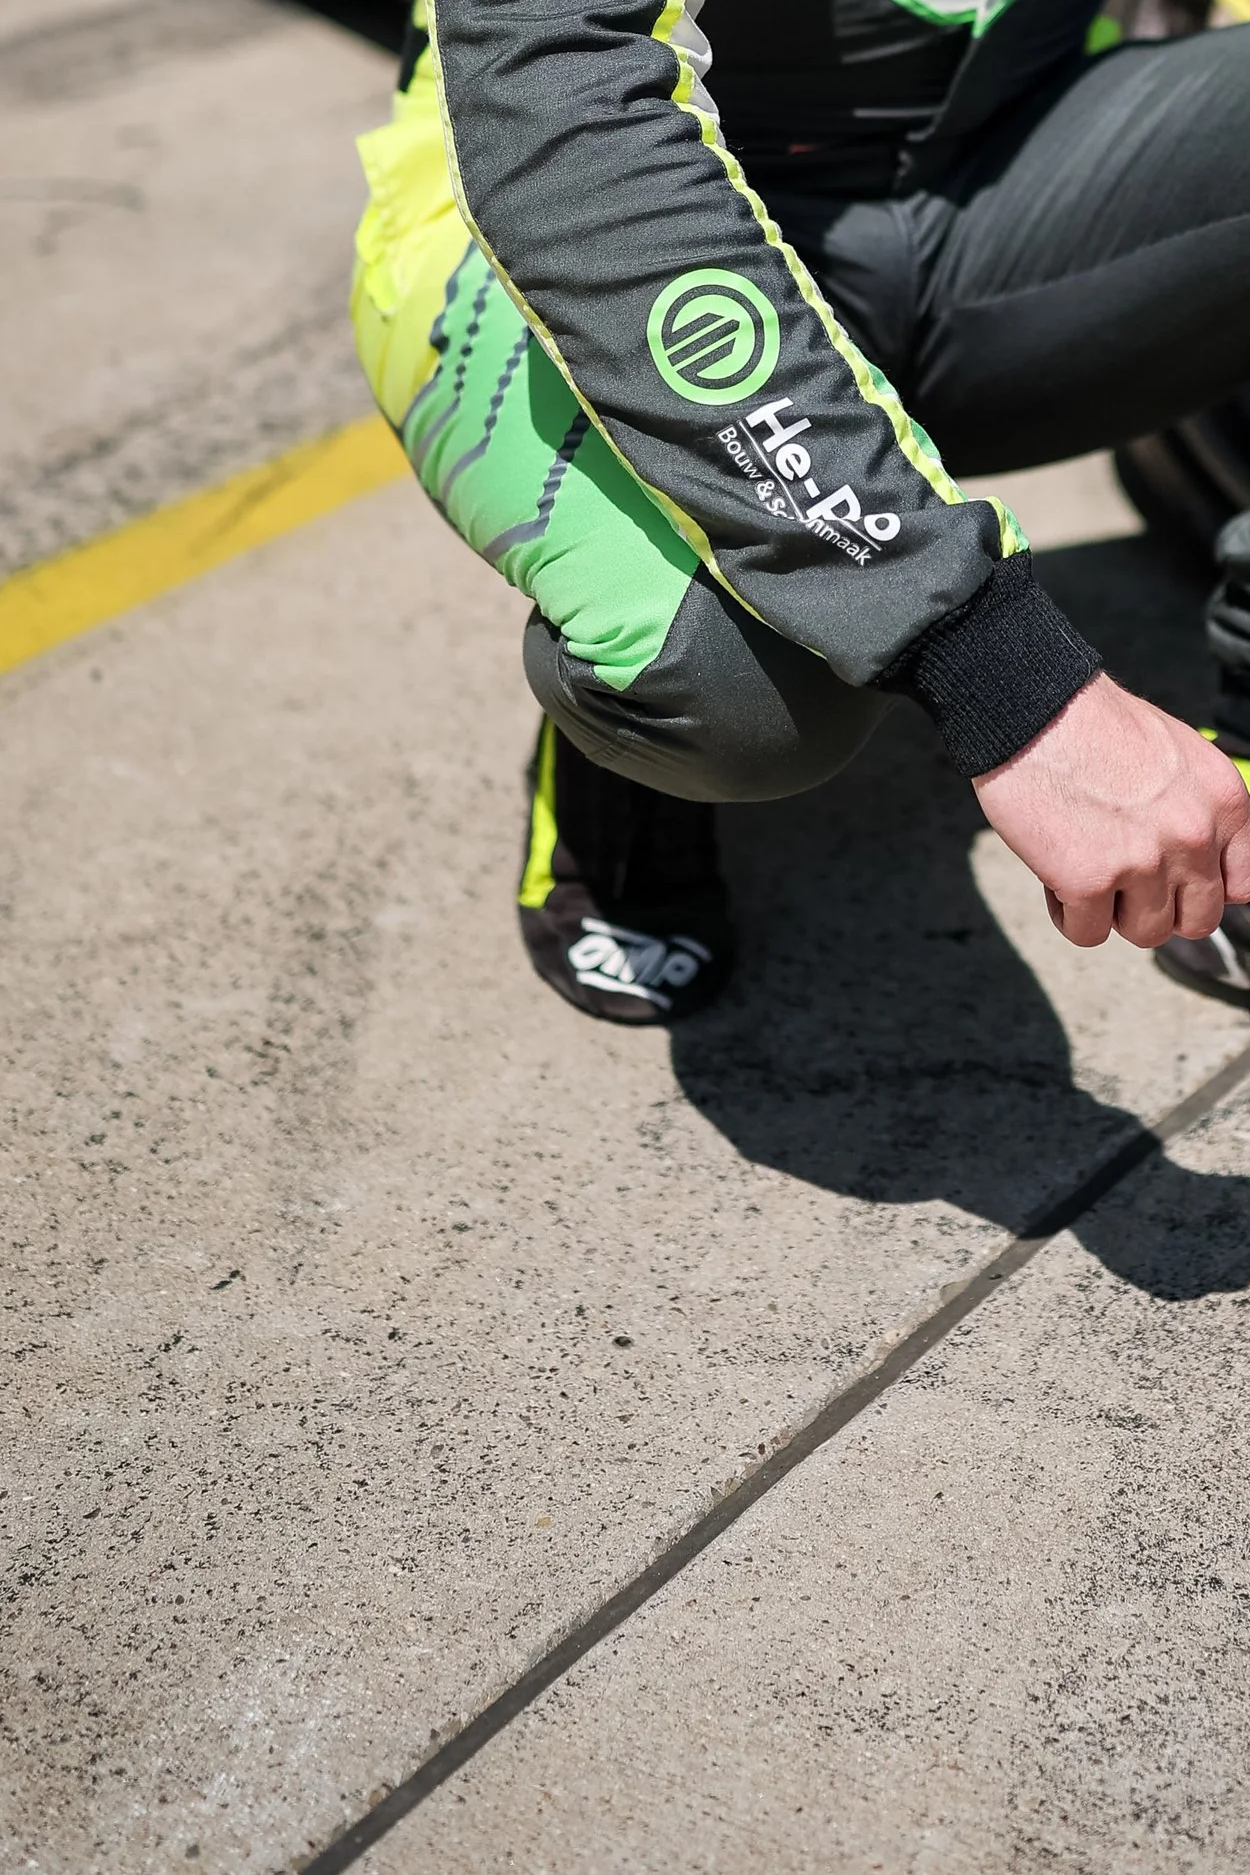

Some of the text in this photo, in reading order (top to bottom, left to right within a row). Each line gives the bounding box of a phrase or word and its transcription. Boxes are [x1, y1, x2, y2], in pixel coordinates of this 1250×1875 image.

[717, 425, 762, 480] Bouw
[756, 478, 776, 502] &
[568, 933, 698, 988] OMP
